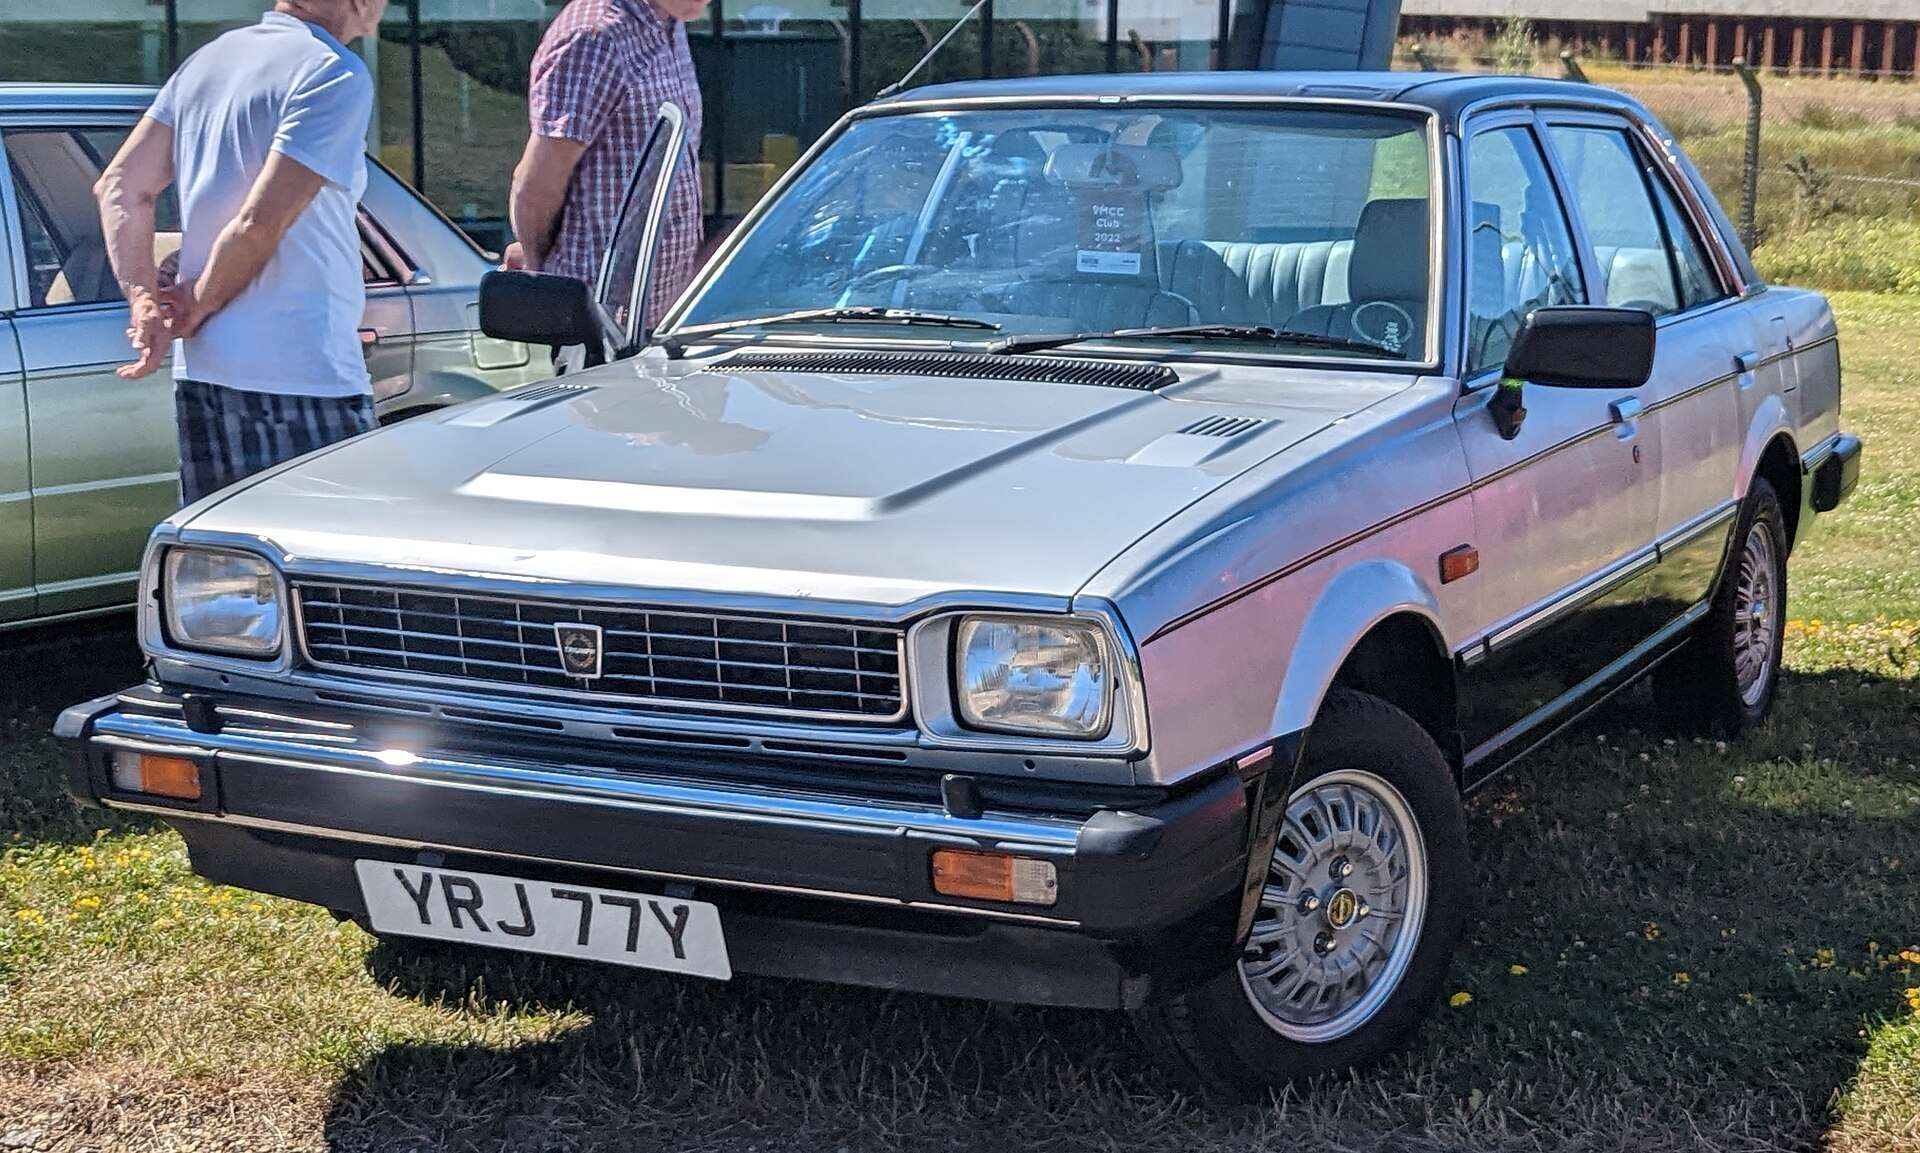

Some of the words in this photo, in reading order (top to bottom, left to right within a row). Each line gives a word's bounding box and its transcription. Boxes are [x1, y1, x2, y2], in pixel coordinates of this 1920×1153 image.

[1096, 217, 1120, 228] Club
[1094, 232, 1121, 243] 2022
[393, 867, 536, 938] YRJ
[550, 887, 690, 960] 77Y
